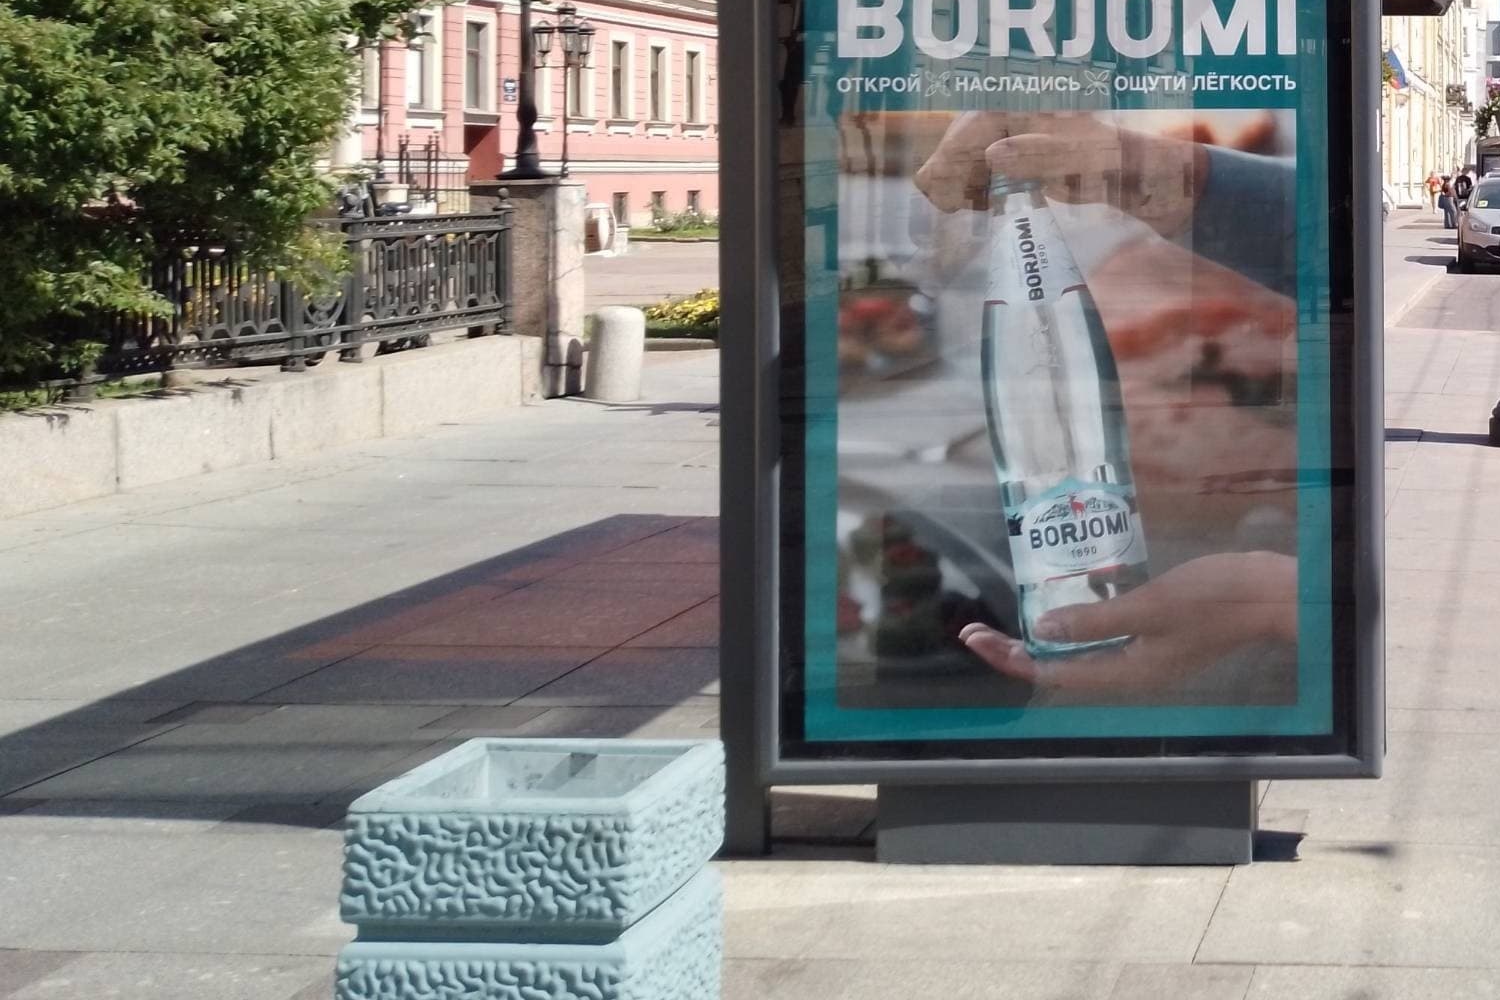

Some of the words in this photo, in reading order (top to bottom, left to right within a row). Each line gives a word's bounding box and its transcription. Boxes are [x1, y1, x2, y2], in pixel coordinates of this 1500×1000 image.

[836, 73, 921, 93] ОТКРОЙ
[955, 75, 1081, 95] НАСЛАДИСЬ
[1113, 74, 1187, 94] ОЩУТИ
[1191, 72, 1297, 92] ЛЁГКОСТЬ
[1014, 216, 1045, 301] BORJOMI
[1037, 243, 1049, 270] 1890
[1029, 510, 1130, 550] BORJOMI
[1071, 545, 1098, 559] 1890
